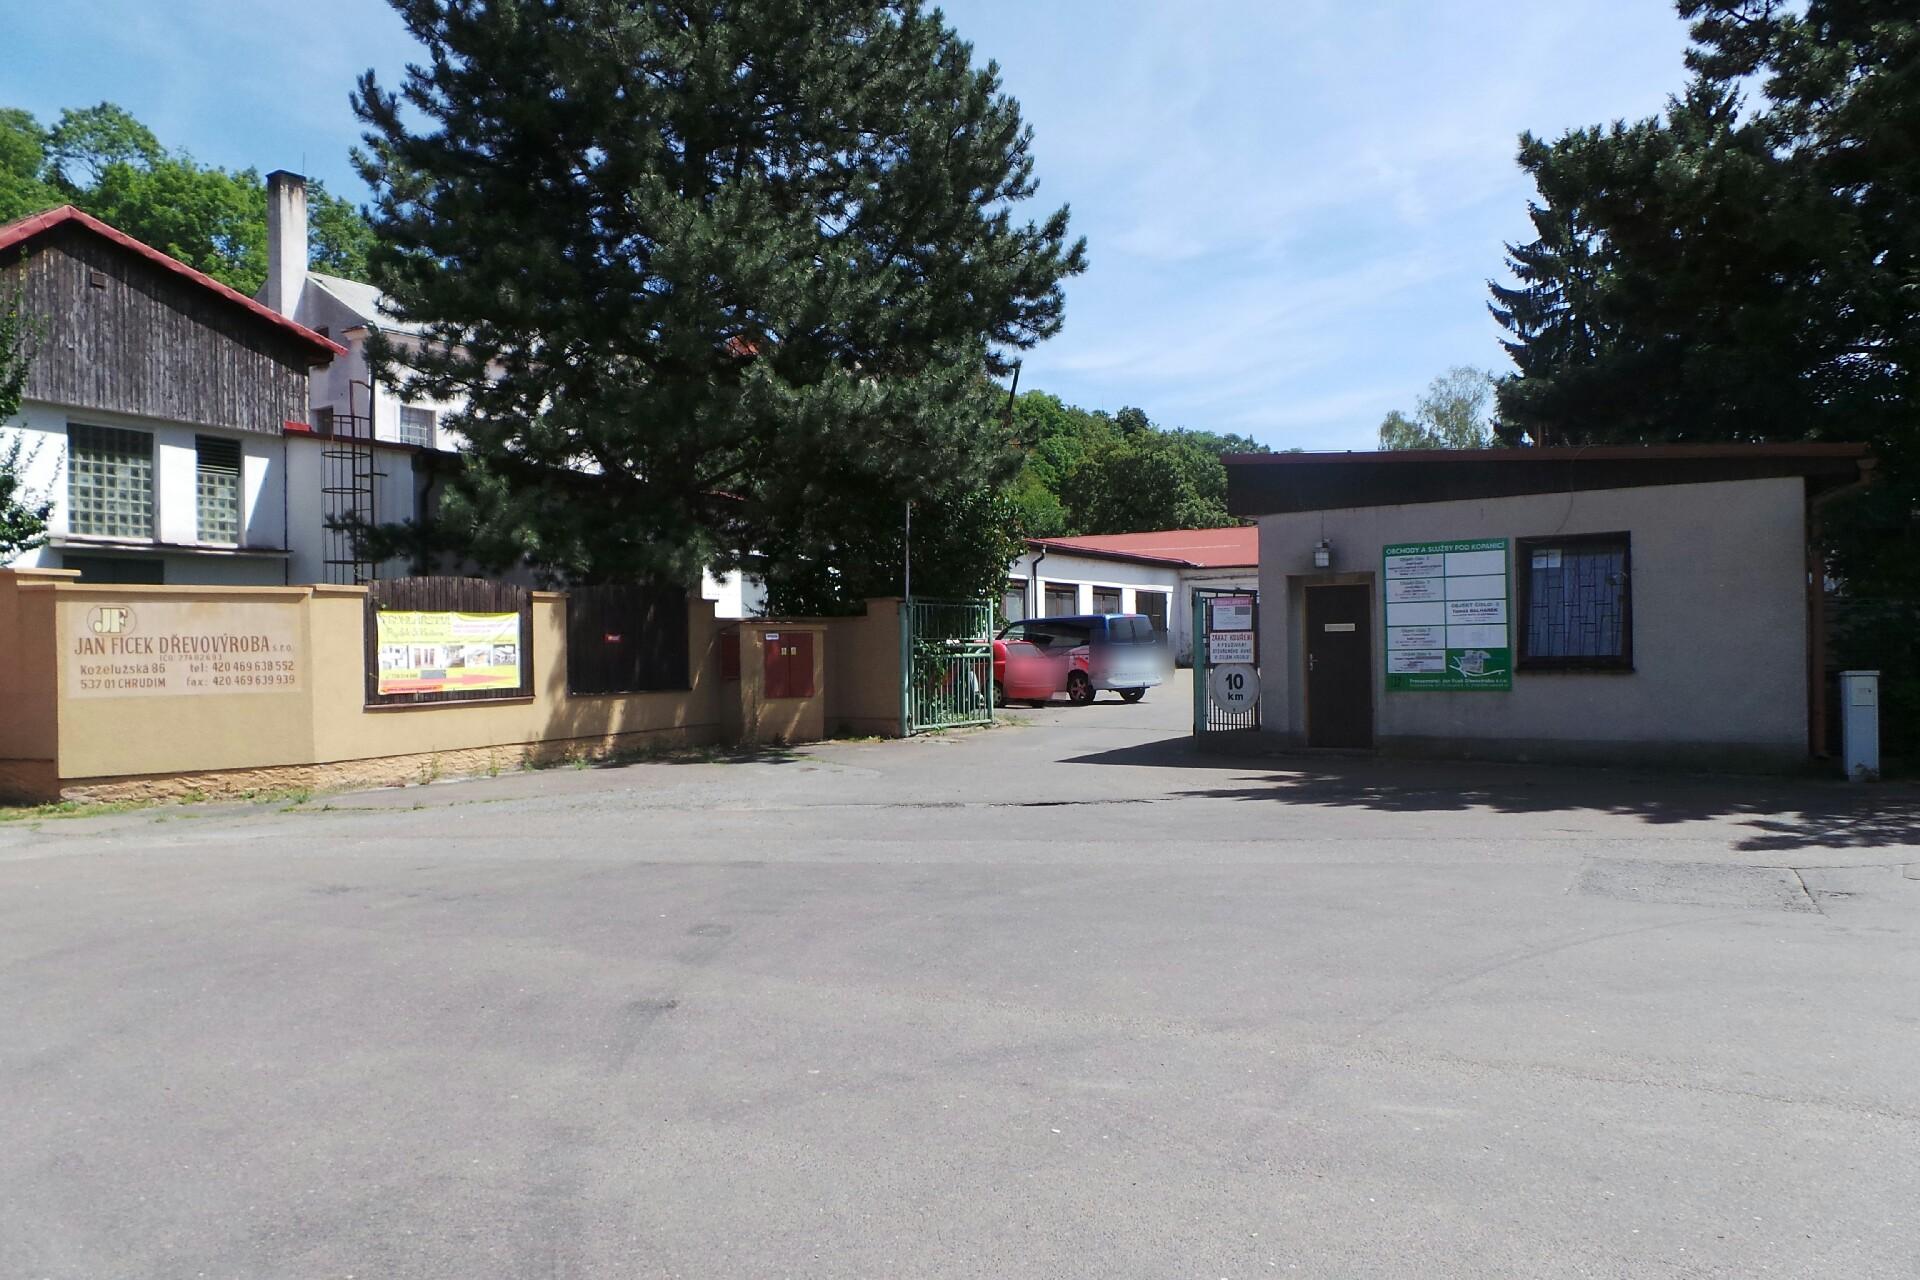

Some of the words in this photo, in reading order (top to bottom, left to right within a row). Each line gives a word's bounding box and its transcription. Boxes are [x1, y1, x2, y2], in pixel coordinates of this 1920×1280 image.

[1386, 547, 1419, 555] OBCHODY
[1428, 543, 1453, 553] SLUŽBY
[1454, 544, 1470, 552] POD
[74, 636, 105, 655] JAN
[111, 636, 153, 655] FICEK
[160, 633, 270, 654] DŘEVOVÝROBA
[80, 663, 149, 675] Koželužská
[151, 662, 166, 674] 86
[213, 661, 231, 673] 420
[233, 661, 252, 672] 469
[254, 660, 274, 672] 638
[275, 660, 295, 671] 552
[81, 678, 102, 690] 537
[104, 678, 116, 689] 01
[118, 677, 166, 689] CHRUDIM
[213, 675, 231, 686] 420
[233, 675, 253, 686] 469
[255, 674, 274, 686] 639
[276, 674, 296, 685] 939
[1225, 673, 1244, 690] 10
[1227, 691, 1244, 701] km
